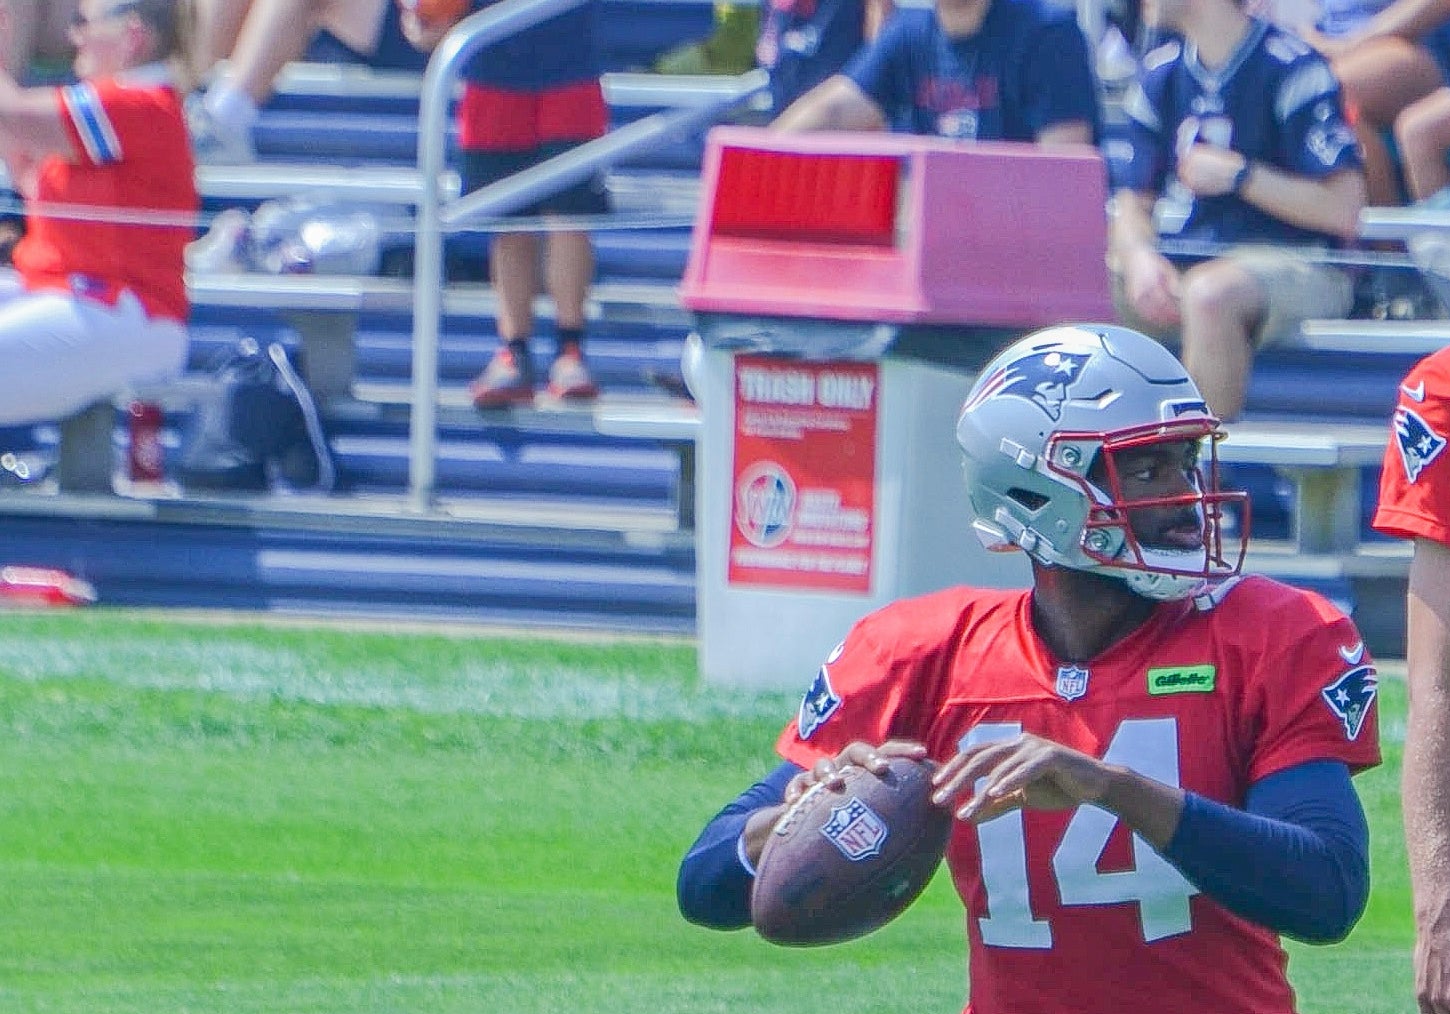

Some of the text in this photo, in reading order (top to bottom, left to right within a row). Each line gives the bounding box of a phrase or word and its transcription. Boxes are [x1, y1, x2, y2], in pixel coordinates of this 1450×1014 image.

[741, 366, 873, 410] TRASH ONLY
[1061, 680, 1081, 694] NFL
[1155, 673, 1211, 688] Gillette
[839, 817, 882, 855] NFL
[957, 716, 1201, 949] 14
